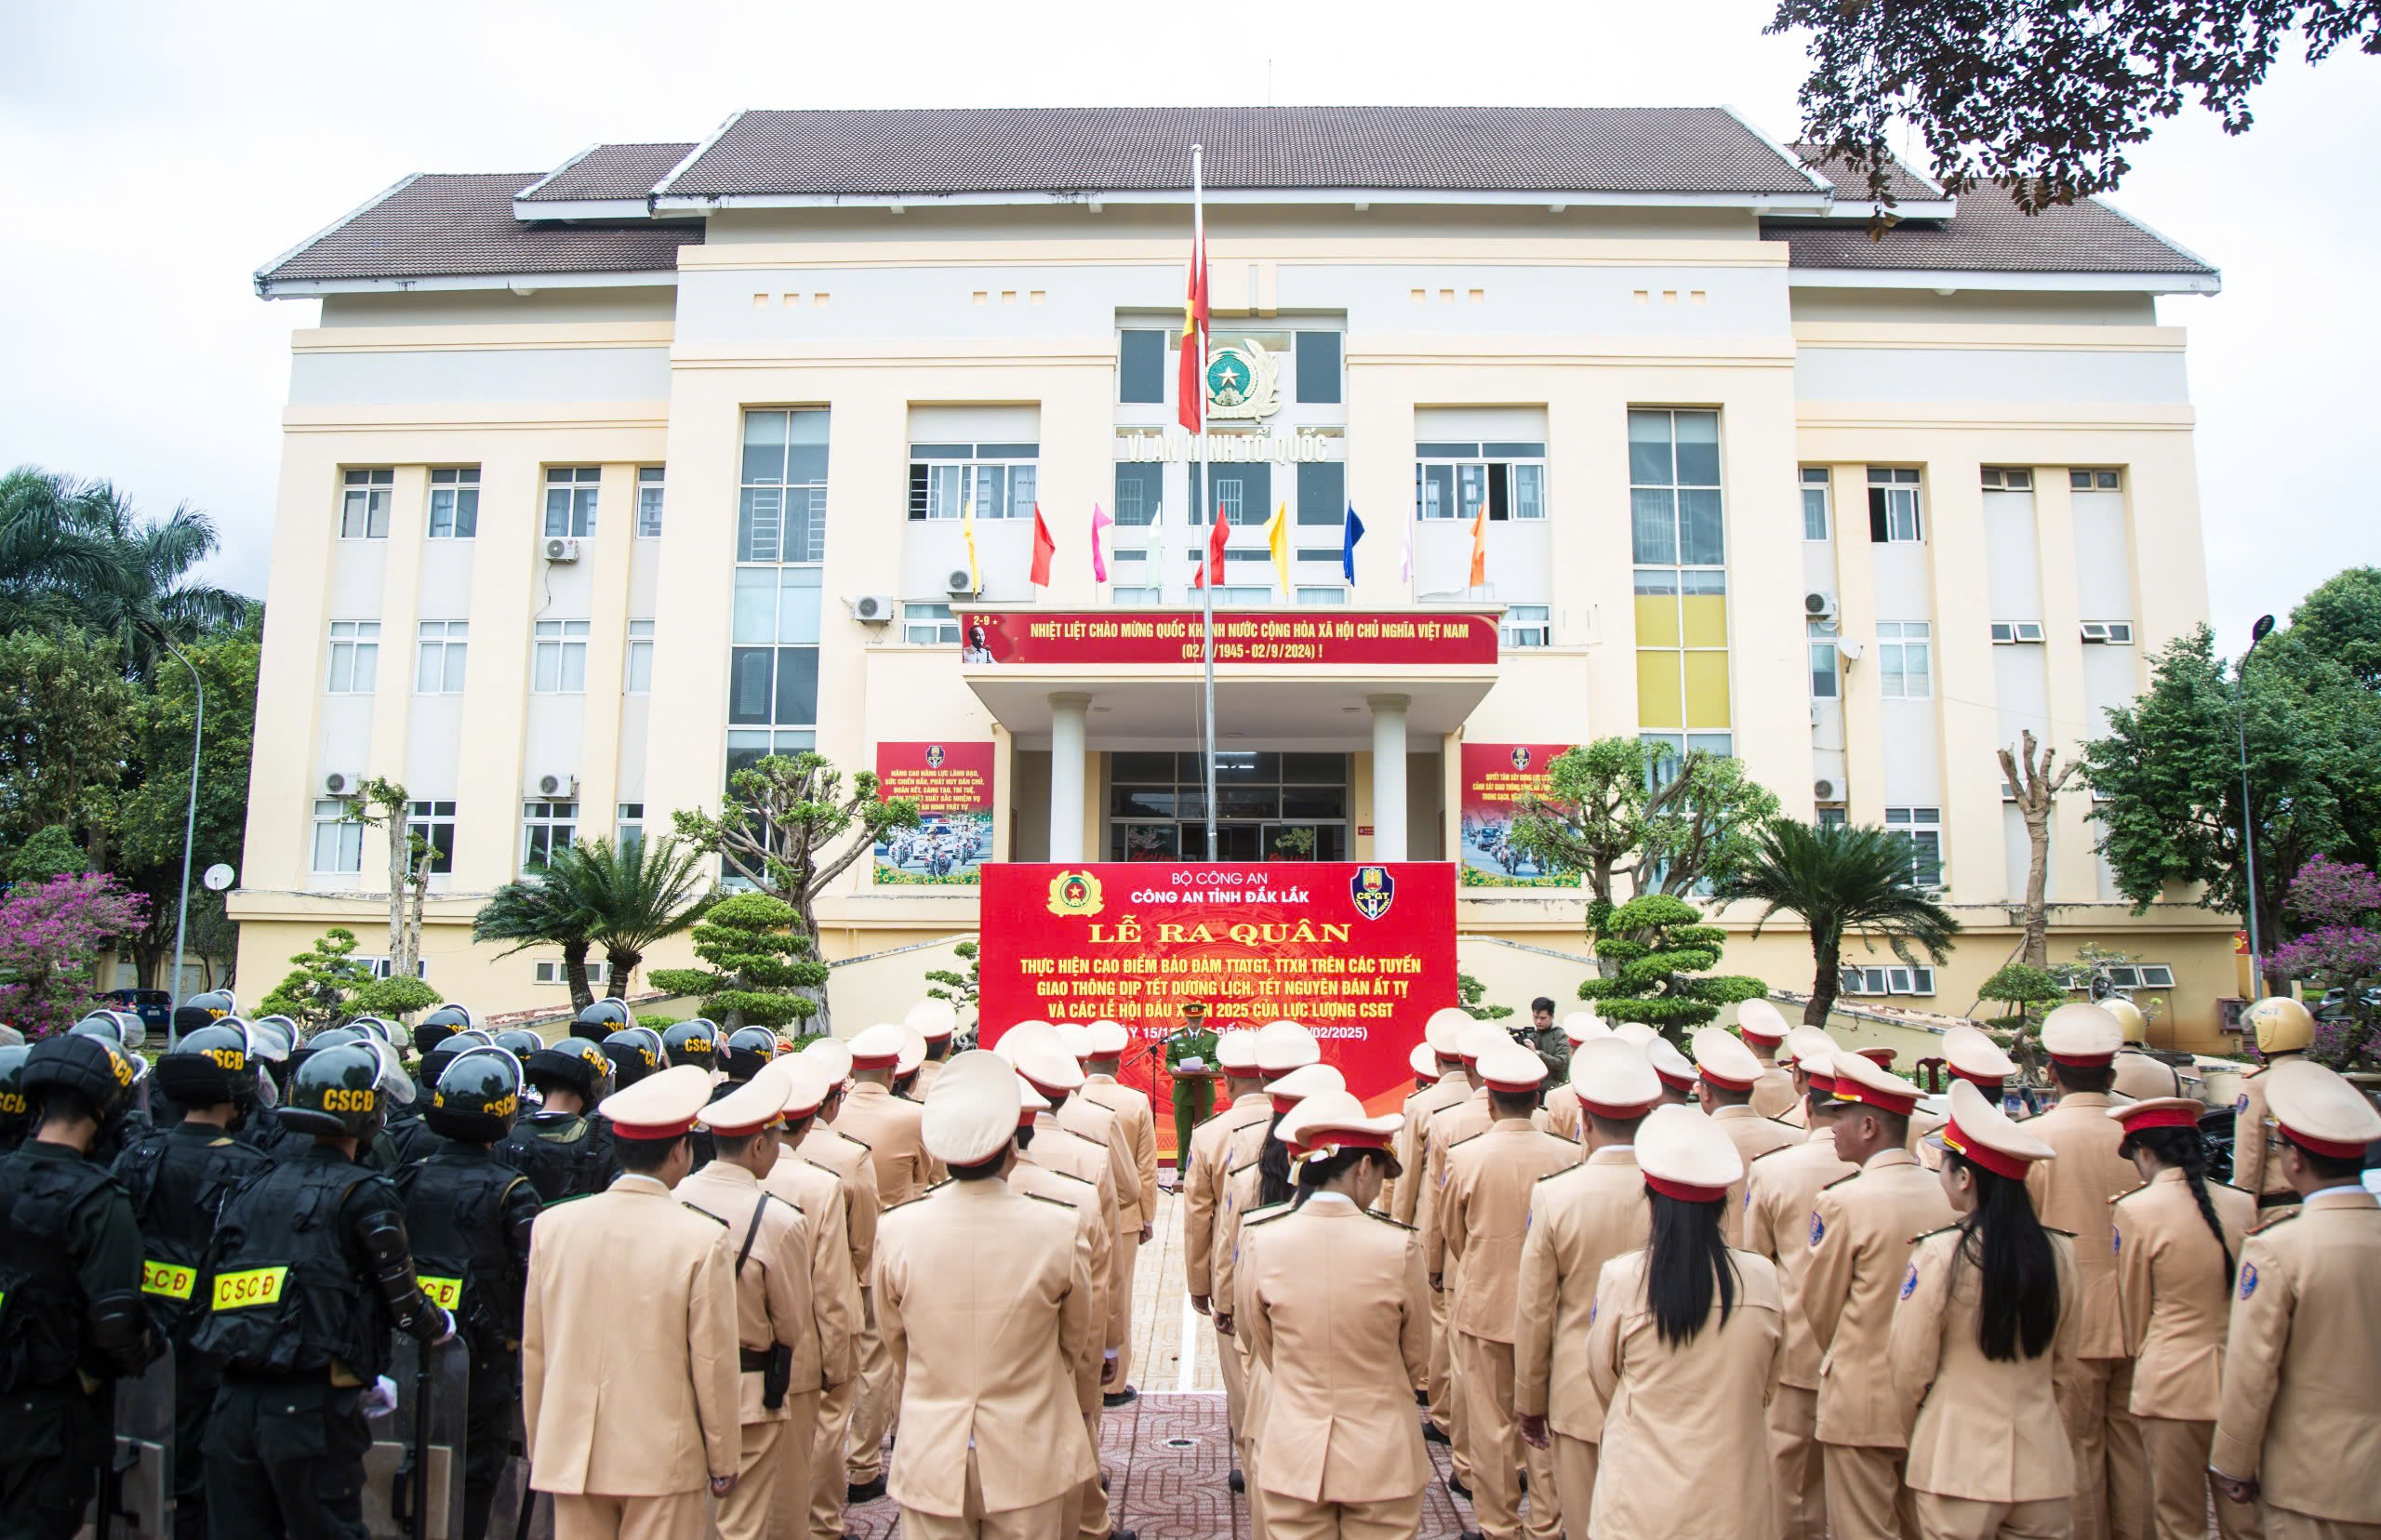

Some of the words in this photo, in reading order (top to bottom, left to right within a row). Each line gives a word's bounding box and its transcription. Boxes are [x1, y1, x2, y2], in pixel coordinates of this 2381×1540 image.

[1152, 434, 1178, 463] AN
[1273, 426, 1328, 466] QUỐC
[973, 615, 991, 626] 2-9
[1030, 620, 1061, 641] NHIỆT
[1064, 620, 1086, 641] LIỆT
[1088, 620, 1118, 638] CHÀO
[1121, 620, 1153, 638] MỪNG
[1156, 618, 1186, 639] QUỐC
[1188, 621, 1226, 639] KHNH
[1228, 620, 1258, 638] NƯỚC
[1260, 620, 1291, 641] CỘNG
[1293, 619, 1315, 638] HÒA
[1318, 621, 1334, 638] XÃ
[1335, 620, 1354, 641] HỘI
[1356, 618, 1379, 638] CHỦ
[1381, 621, 1416, 639] NGHĨA
[1417, 620, 1442, 642] VIỆT
[1443, 623, 1470, 639] NAM
[1172, 870, 1192, 886] BỘ
[1196, 870, 1244, 884] CÔNG
[1246, 872, 1268, 884] AN
[1130, 888, 1178, 903] CÔNG
[1181, 891, 1204, 903] AN
[1207, 887, 1242, 903] TỈNH
[1244, 885, 1278, 903] ĐẮK
[1281, 886, 1310, 903] LẮK
[1086, 914, 1142, 943] LỄ
[1157, 923, 1216, 943] RA
[1229, 918, 1351, 947] QUÂN
[1020, 958, 1055, 976] THỰC
[1057, 956, 1090, 976] HIỆN
[1093, 959, 1120, 974] CAO
[1123, 955, 1158, 974] ĐIỂM
[1161, 955, 1189, 974] BẢO
[1191, 955, 1222, 974] ĐẢM
[1226, 959, 1271, 976] TTATGT,
[1274, 958, 1308, 974] TTXH
[1310, 956, 1345, 974] TRÊN
[1348, 956, 1376, 974] CÁC
[1378, 954, 1421, 974] TUYẾN
[1037, 981, 1069, 996] GIAO
[1071, 978, 1116, 996] THÔNG
[1119, 981, 1142, 999] DỊP
[1145, 976, 1169, 996] TẾT
[1171, 980, 1217, 996] DƯƠNG
[1221, 980, 1255, 999] LỊCH,
[1258, 976, 1282, 996] TẾT
[1284, 978, 1338, 996] NGUYÊN
[1341, 978, 1370, 996] ĐÁN
[1373, 976, 1390, 996] ẤT
[1392, 981, 1409, 999] TỴ
[1047, 1001, 1066, 1018] VÀ
[1069, 1001, 1097, 1018] CÁC
[1099, 999, 1115, 1018] LỄ
[1119, 1001, 1142, 1021] HỘI
[1145, 999, 1173, 1018] ĐẦU
[1216, 1002, 1249, 1018] 2025
[1253, 999, 1280, 1018] CỦA
[1283, 1002, 1309, 1021] LỰC
[1312, 1002, 1356, 1021] LƯỢNG
[1359, 1002, 1394, 1018] CSGT
[220, 1274, 275, 1302] CSCĐ
